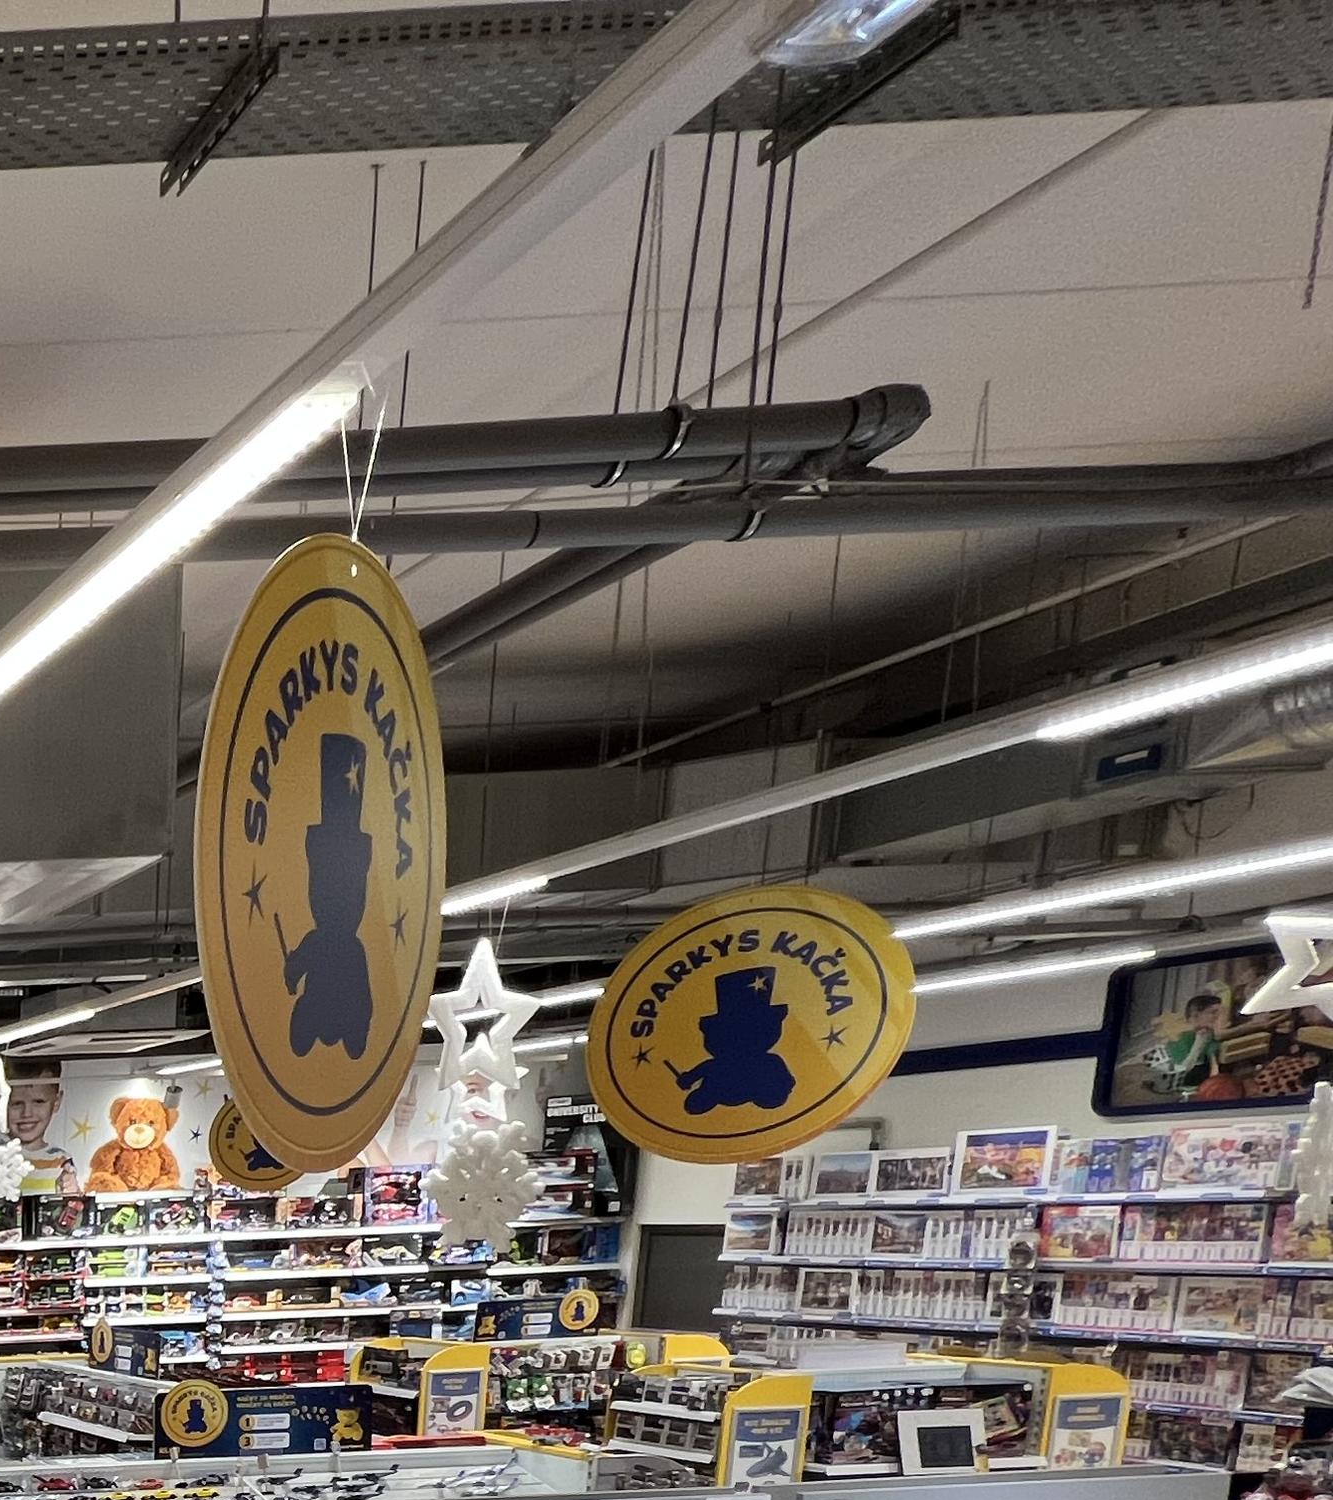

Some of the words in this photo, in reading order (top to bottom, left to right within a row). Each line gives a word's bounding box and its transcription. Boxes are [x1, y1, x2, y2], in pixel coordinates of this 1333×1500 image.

[243, 638, 359, 847] SPARKYS
[363, 666, 414, 881] KAČKA
[628, 929, 762, 1040] SPARKYS
[768, 929, 856, 1018] KAČKA
